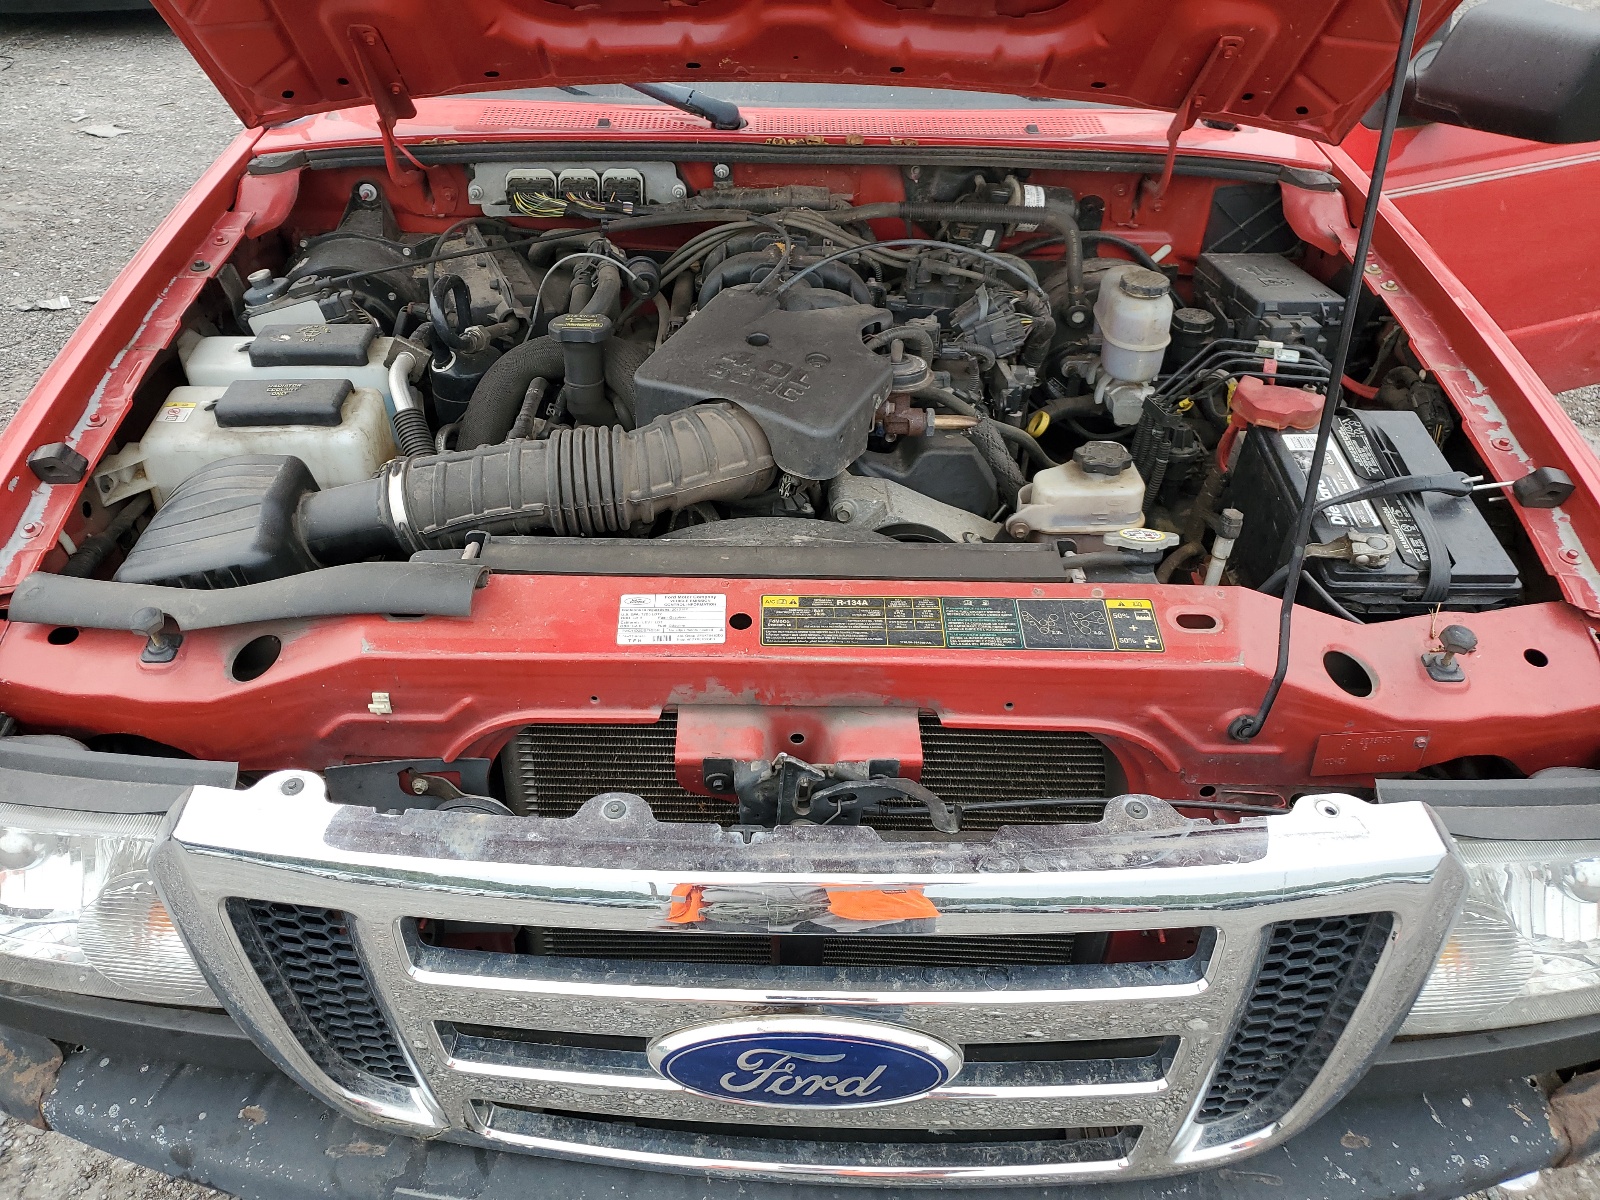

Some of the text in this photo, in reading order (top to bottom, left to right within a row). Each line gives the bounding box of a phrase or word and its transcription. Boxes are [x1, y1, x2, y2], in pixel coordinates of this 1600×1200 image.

[1382, 506, 1396, 526] POISON
[1394, 528, 1411, 549] DANGER
[719, 1047, 888, 1098] Ford
